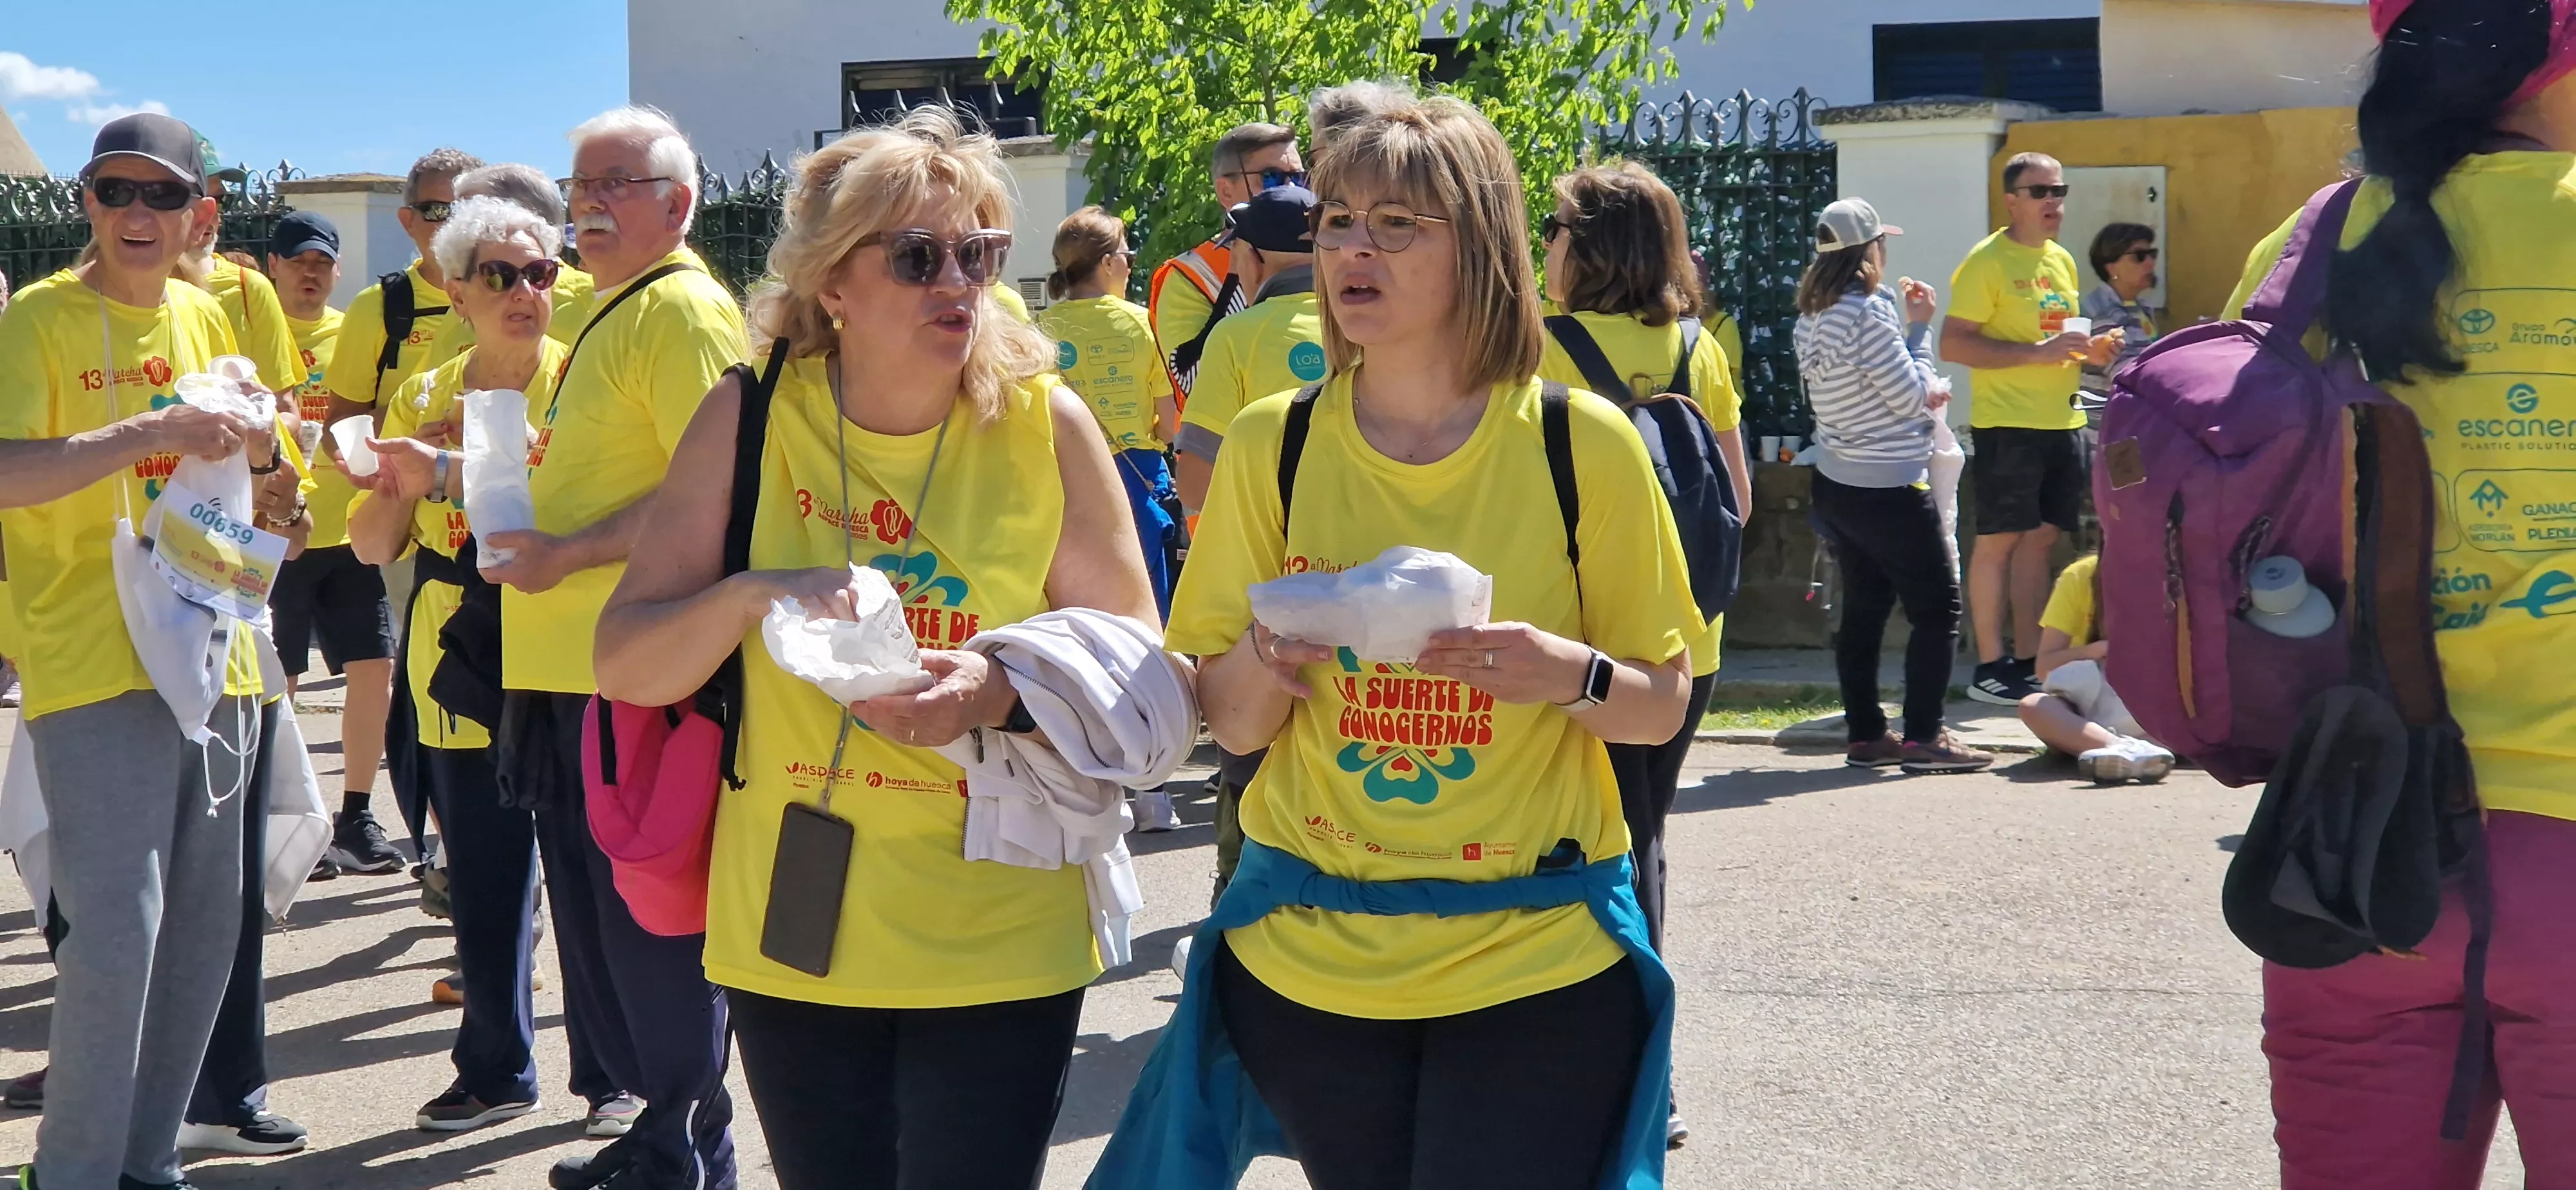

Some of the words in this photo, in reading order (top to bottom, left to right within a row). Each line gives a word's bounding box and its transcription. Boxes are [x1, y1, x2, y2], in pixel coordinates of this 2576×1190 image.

[189, 503, 254, 545] 00659
[1332, 676, 1362, 707] LA
[1366, 677, 1461, 713] SUERTE
[886, 776, 907, 786] hoya
